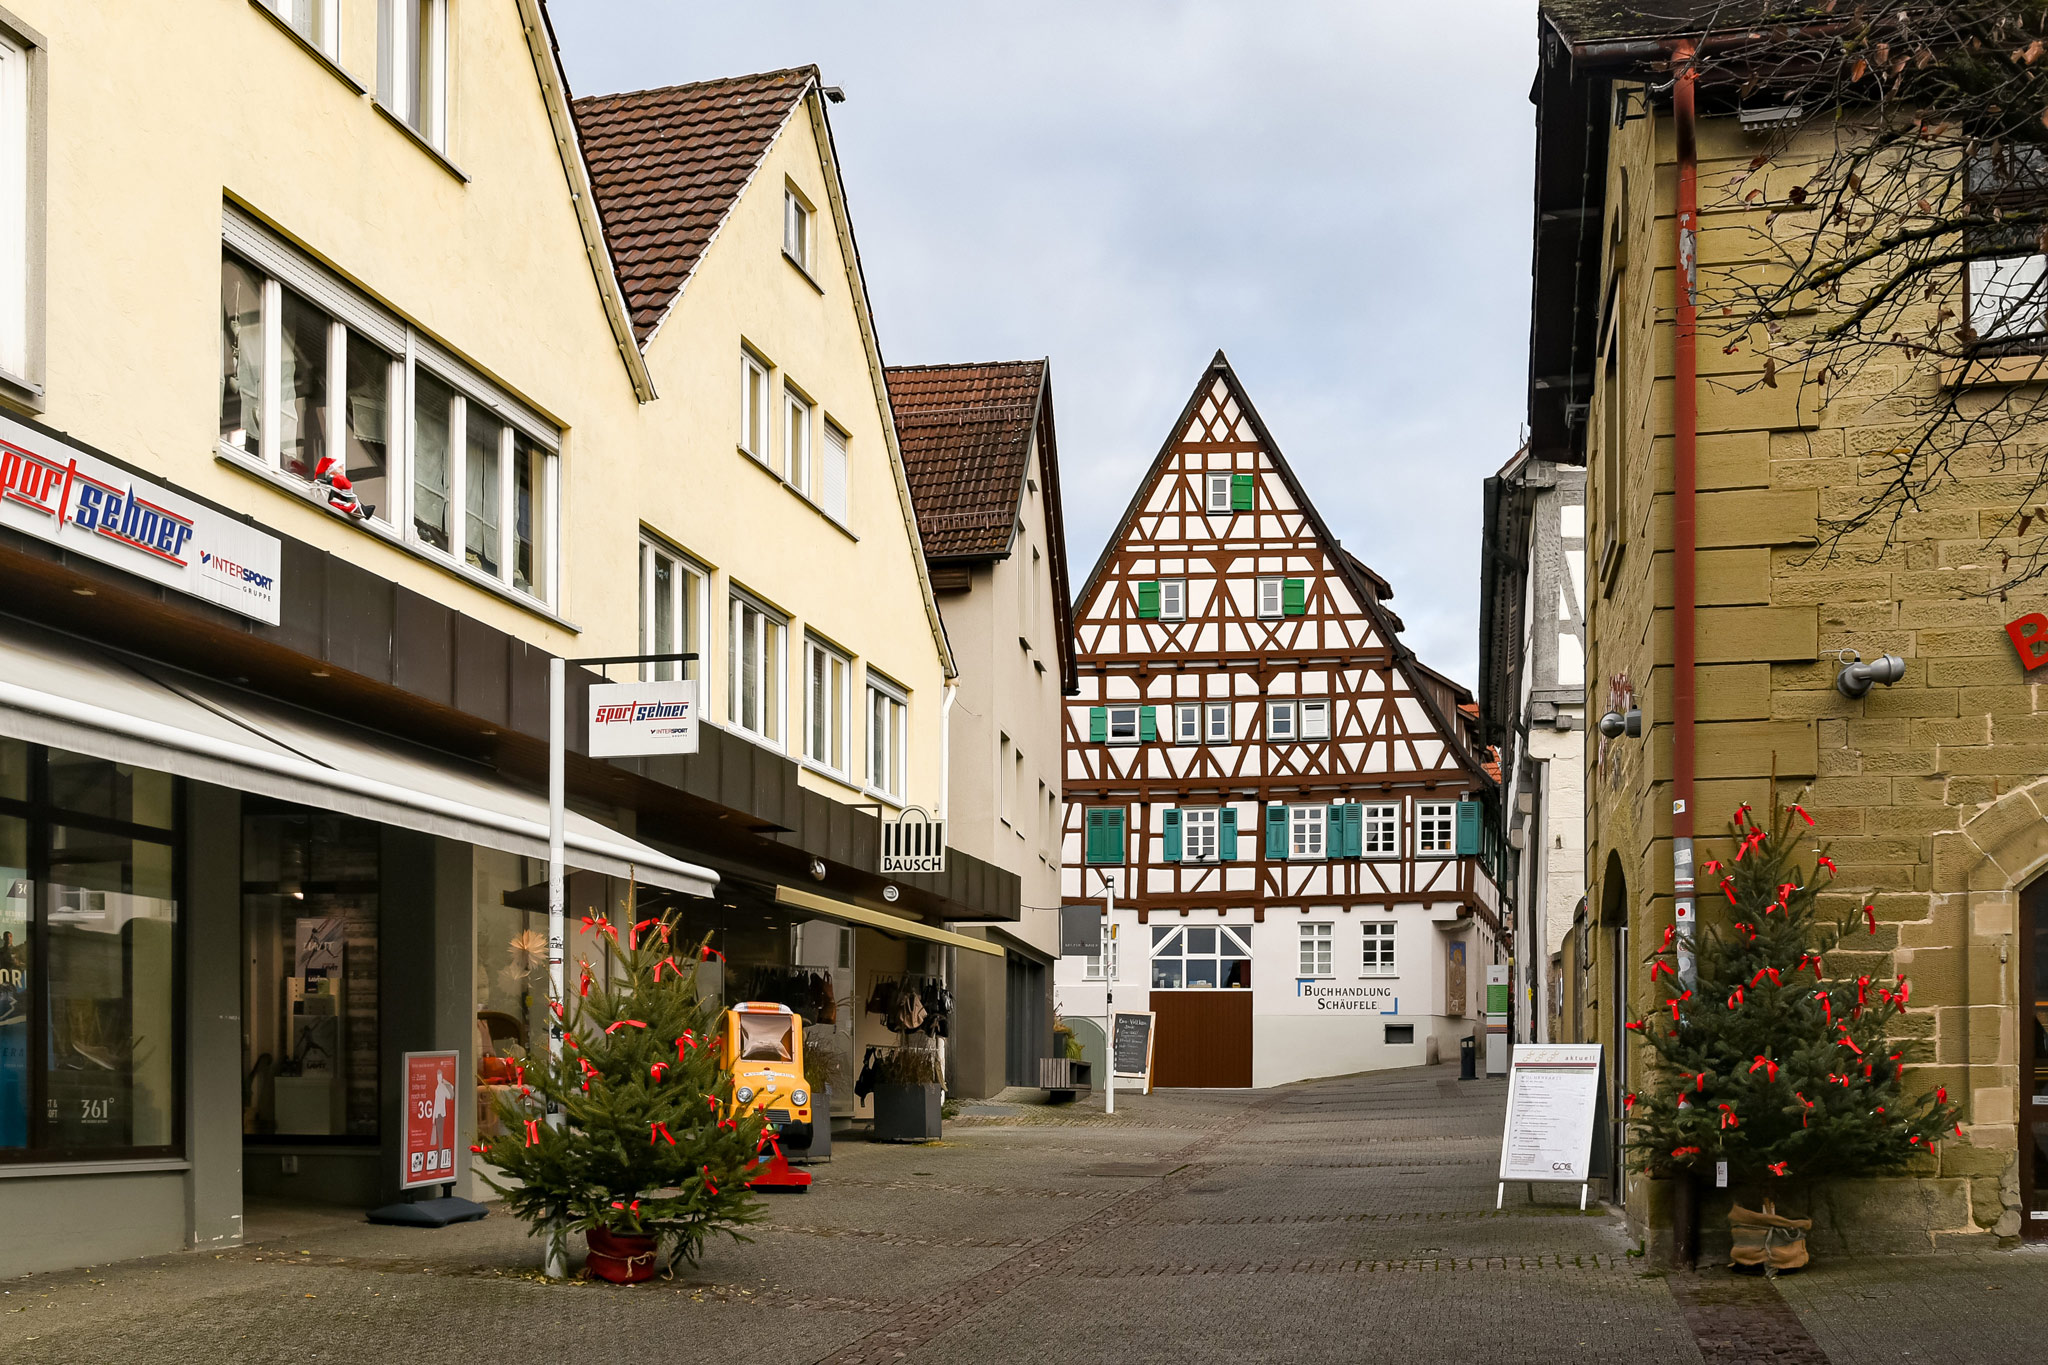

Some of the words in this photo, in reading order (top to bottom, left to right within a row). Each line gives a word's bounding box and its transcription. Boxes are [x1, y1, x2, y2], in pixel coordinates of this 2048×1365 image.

[0, 451, 76, 529] port
[212, 555, 273, 591] INTERSPORT
[242, 586, 271, 602] GRUPPE
[884, 857, 942, 871] BAUSCH
[1304, 985, 1391, 996] BUCHHANDLUNG
[1317, 998, 1377, 1010] SCHÄUFELE
[417, 1100, 433, 1119] 3G
